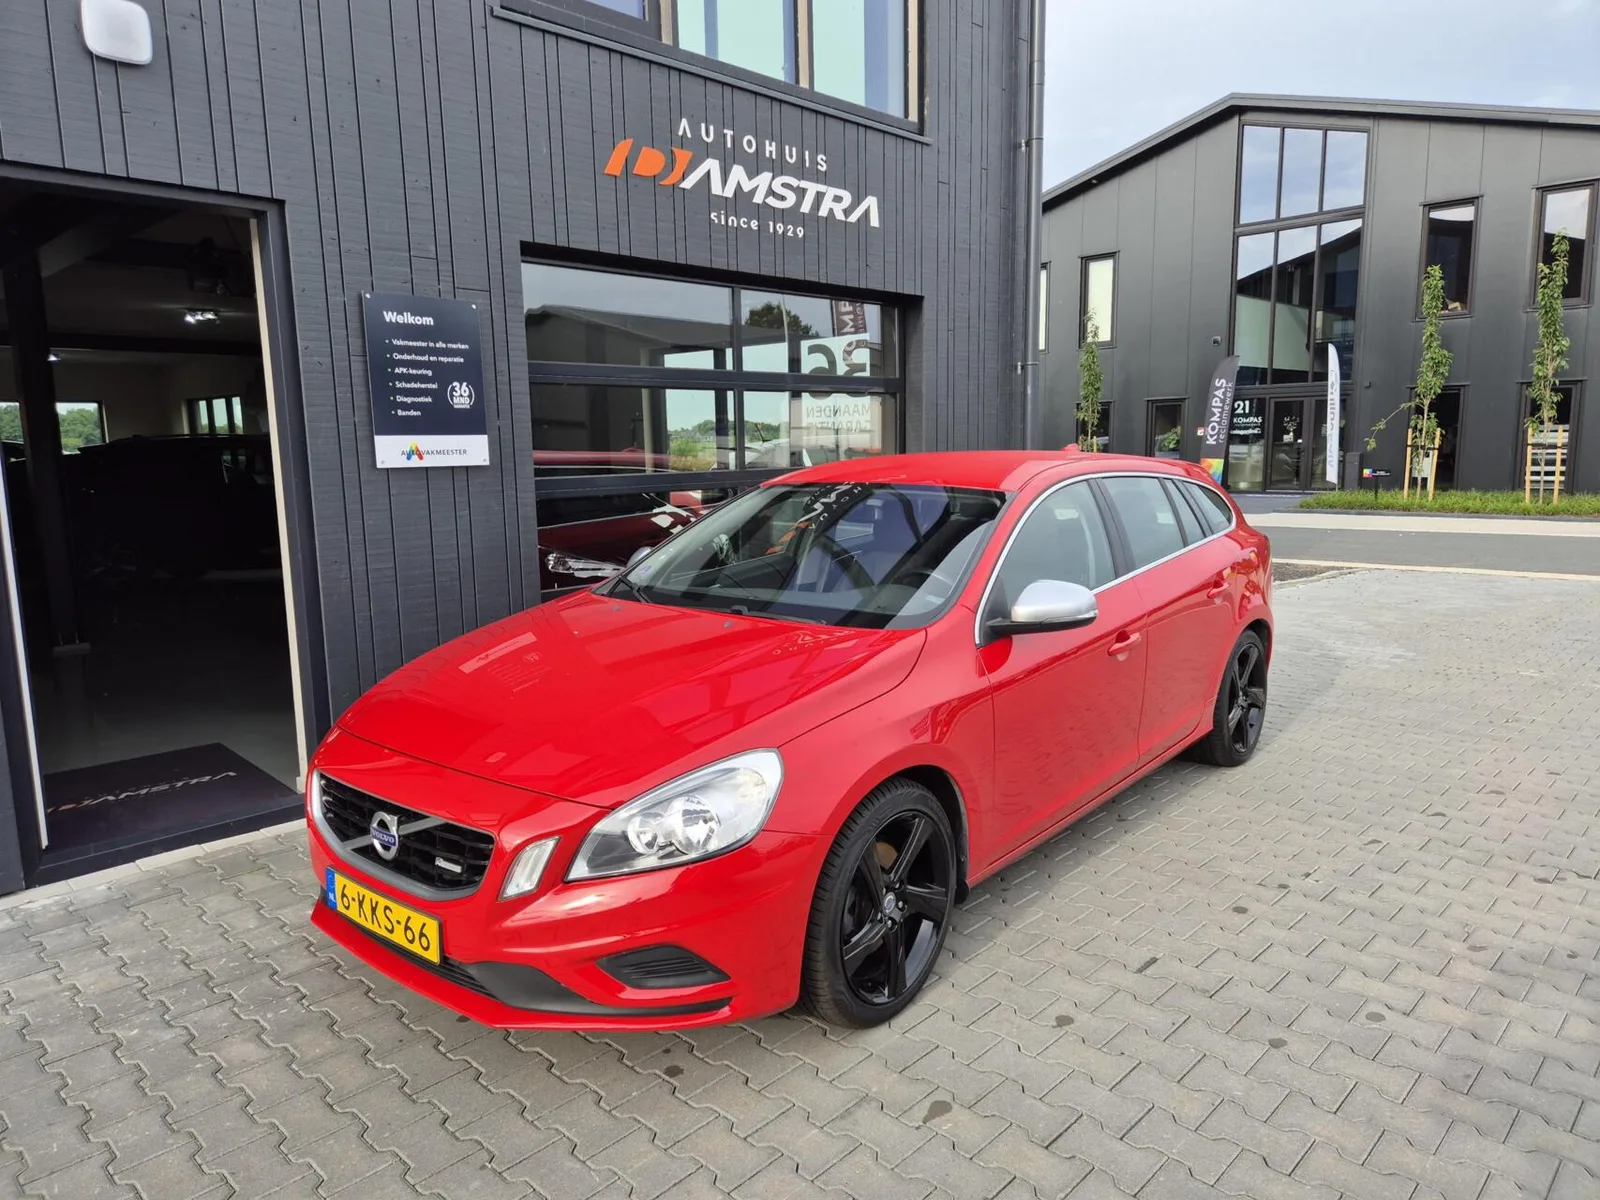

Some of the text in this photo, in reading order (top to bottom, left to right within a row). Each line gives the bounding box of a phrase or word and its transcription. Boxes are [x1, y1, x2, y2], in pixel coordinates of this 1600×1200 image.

[678, 117, 828, 172] AUTOHUIS
[710, 210, 805, 238] since 1929
[383, 310, 435, 326] Welkom
[391, 338, 428, 347] Vakmeester
[447, 342, 470, 350] merken
[392, 352, 429, 361] Onderhoud
[394, 366, 433, 377] APK-keuring
[395, 381, 439, 390] Schadeherstel
[452, 381, 470, 396] 36
[396, 395, 433, 404] Diagnostiek
[453, 396, 470, 404] MND
[397, 409, 422, 417] Banden
[1206, 377, 1227, 445] KOMPAS
[1218, 381, 1234, 444] reclamewerk
[1234, 400, 1250, 414] 21
[372, 829, 395, 844] VOLVO
[340, 883, 431, 952] 6-KKS-66
